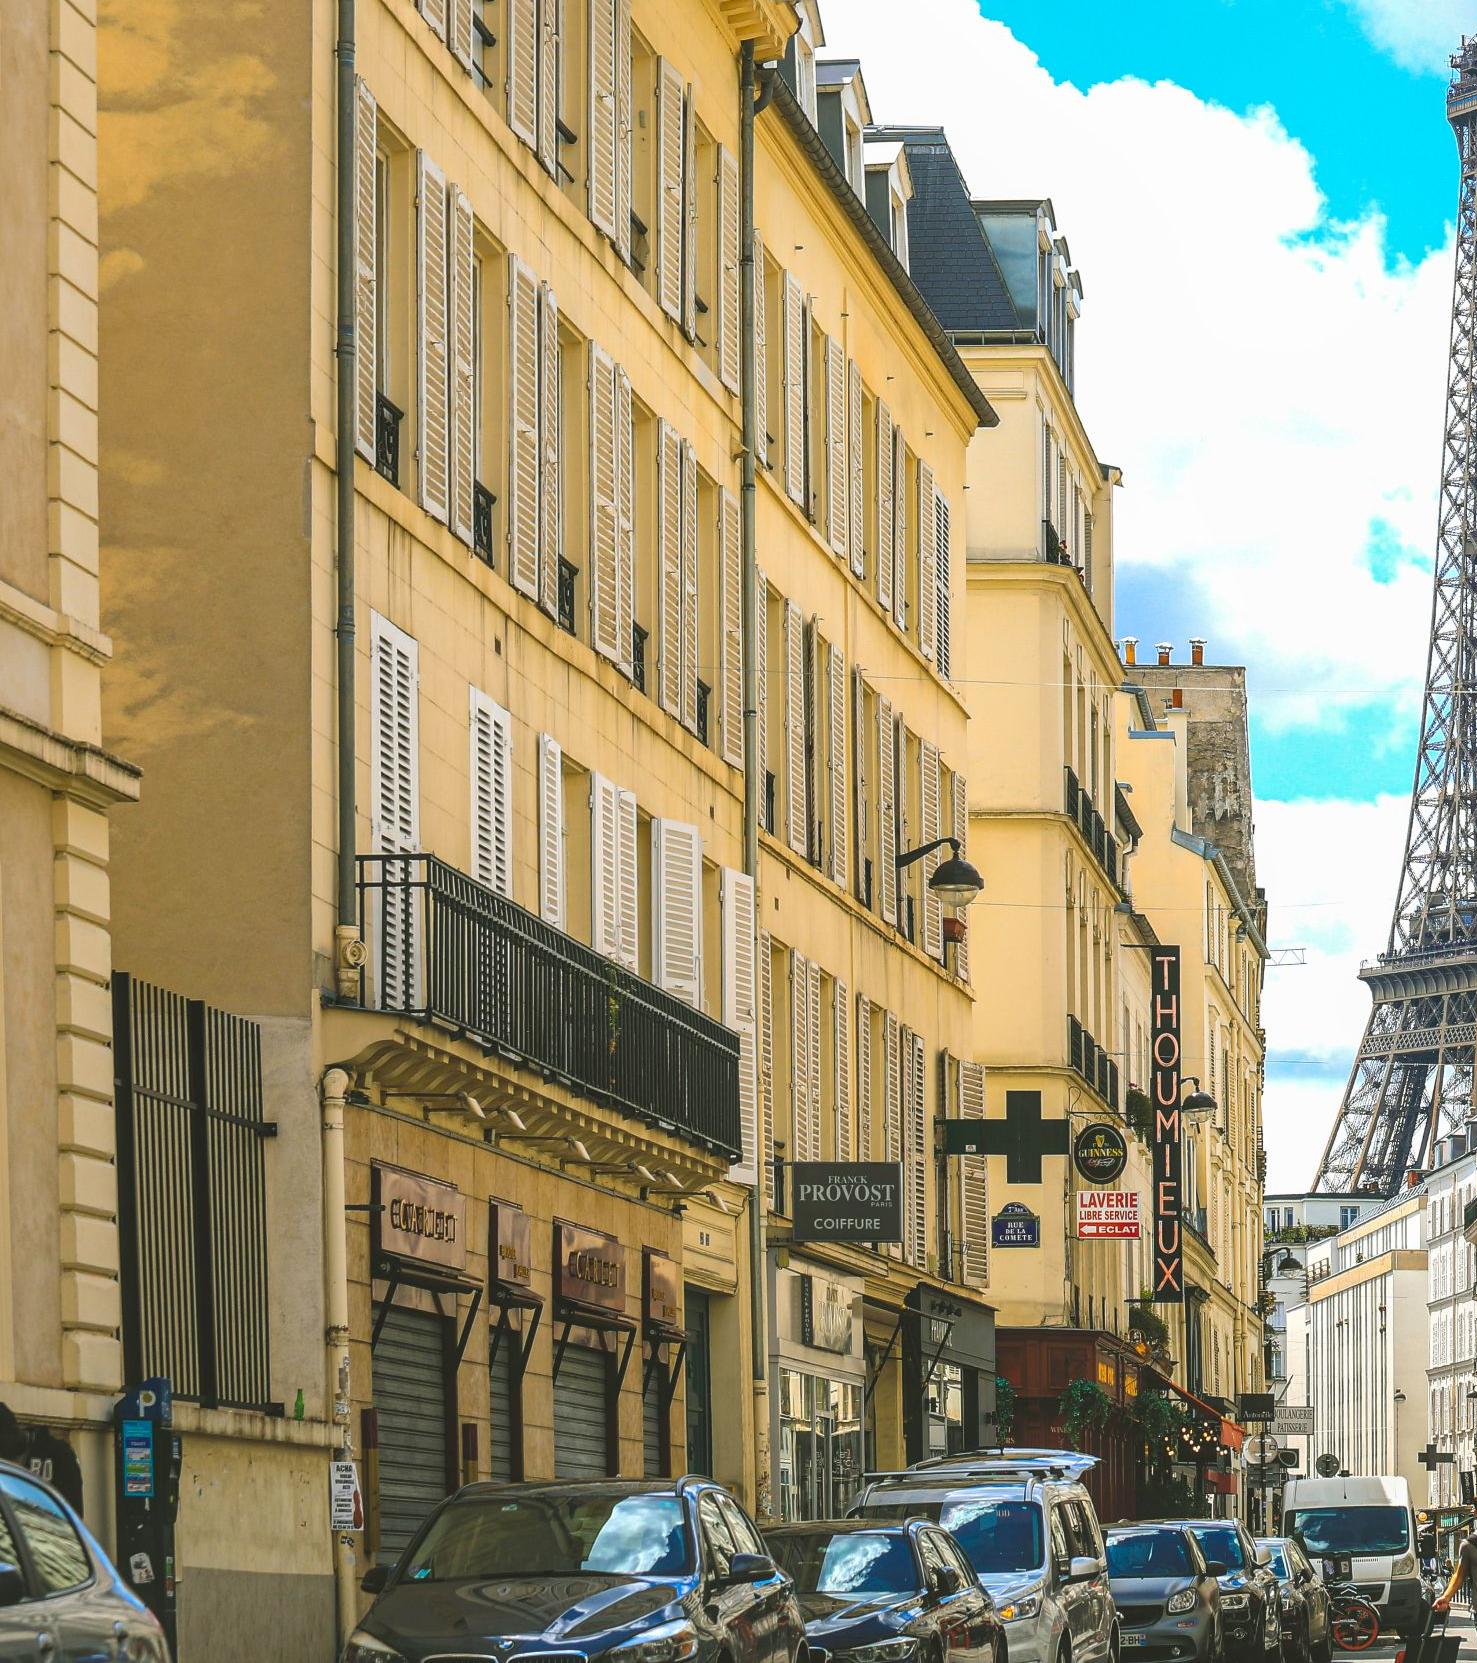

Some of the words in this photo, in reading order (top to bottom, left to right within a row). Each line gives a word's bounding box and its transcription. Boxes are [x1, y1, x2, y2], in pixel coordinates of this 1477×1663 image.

[1153, 956, 1180, 1293] THOUMIEUX
[1078, 1148, 1124, 1158] GUINNESS
[828, 1175, 868, 1184] FRANCK
[799, 1184, 895, 1202] PROVOST
[1079, 1192, 1138, 1208] LAVERIE
[1079, 1210, 1102, 1220] LIBRE
[1104, 1210, 1138, 1220] SERVICE
[813, 1218, 881, 1230] COIFFURE
[1098, 1225, 1138, 1234] ECLAT
[1277, 1422, 1308, 1433] PATISSERIE
